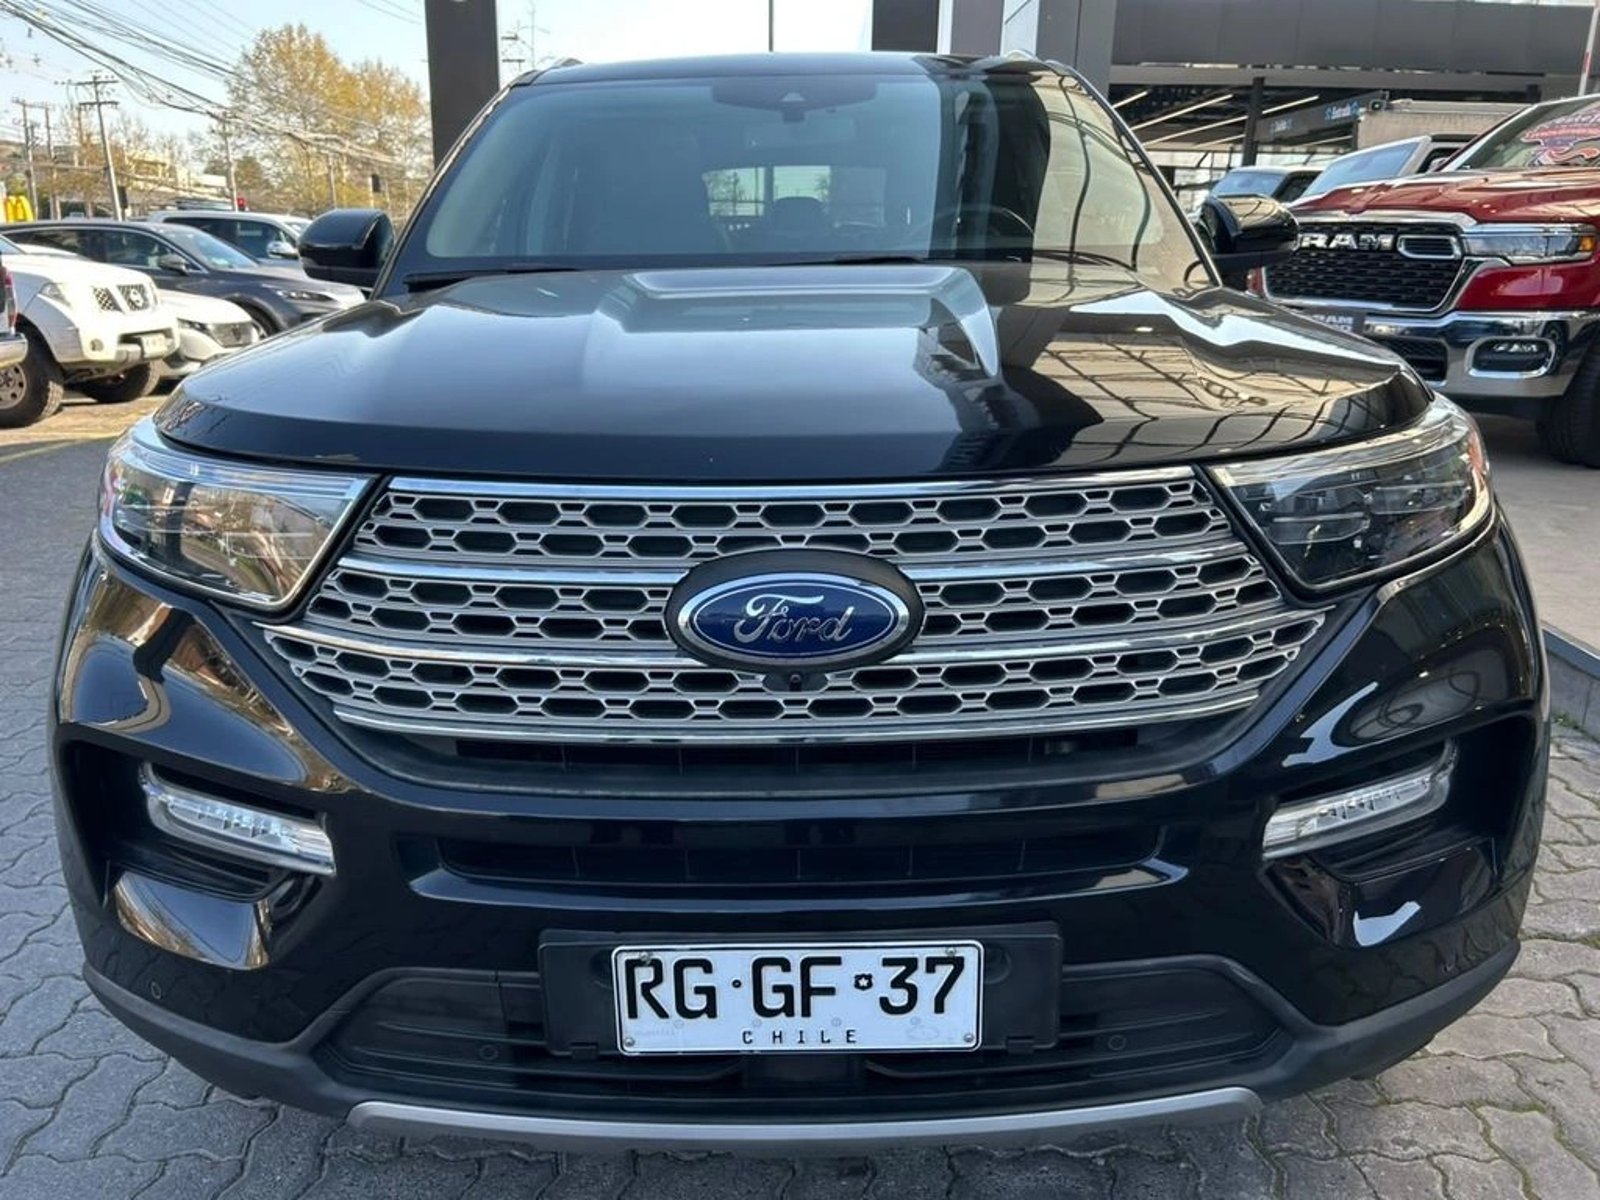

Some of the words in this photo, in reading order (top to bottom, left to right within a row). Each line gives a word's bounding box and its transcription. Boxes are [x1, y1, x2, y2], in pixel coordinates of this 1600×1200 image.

[1298, 232, 1395, 250] RAM
[734, 593, 855, 643] Ford
[741, 1029, 857, 1045] CHILE
